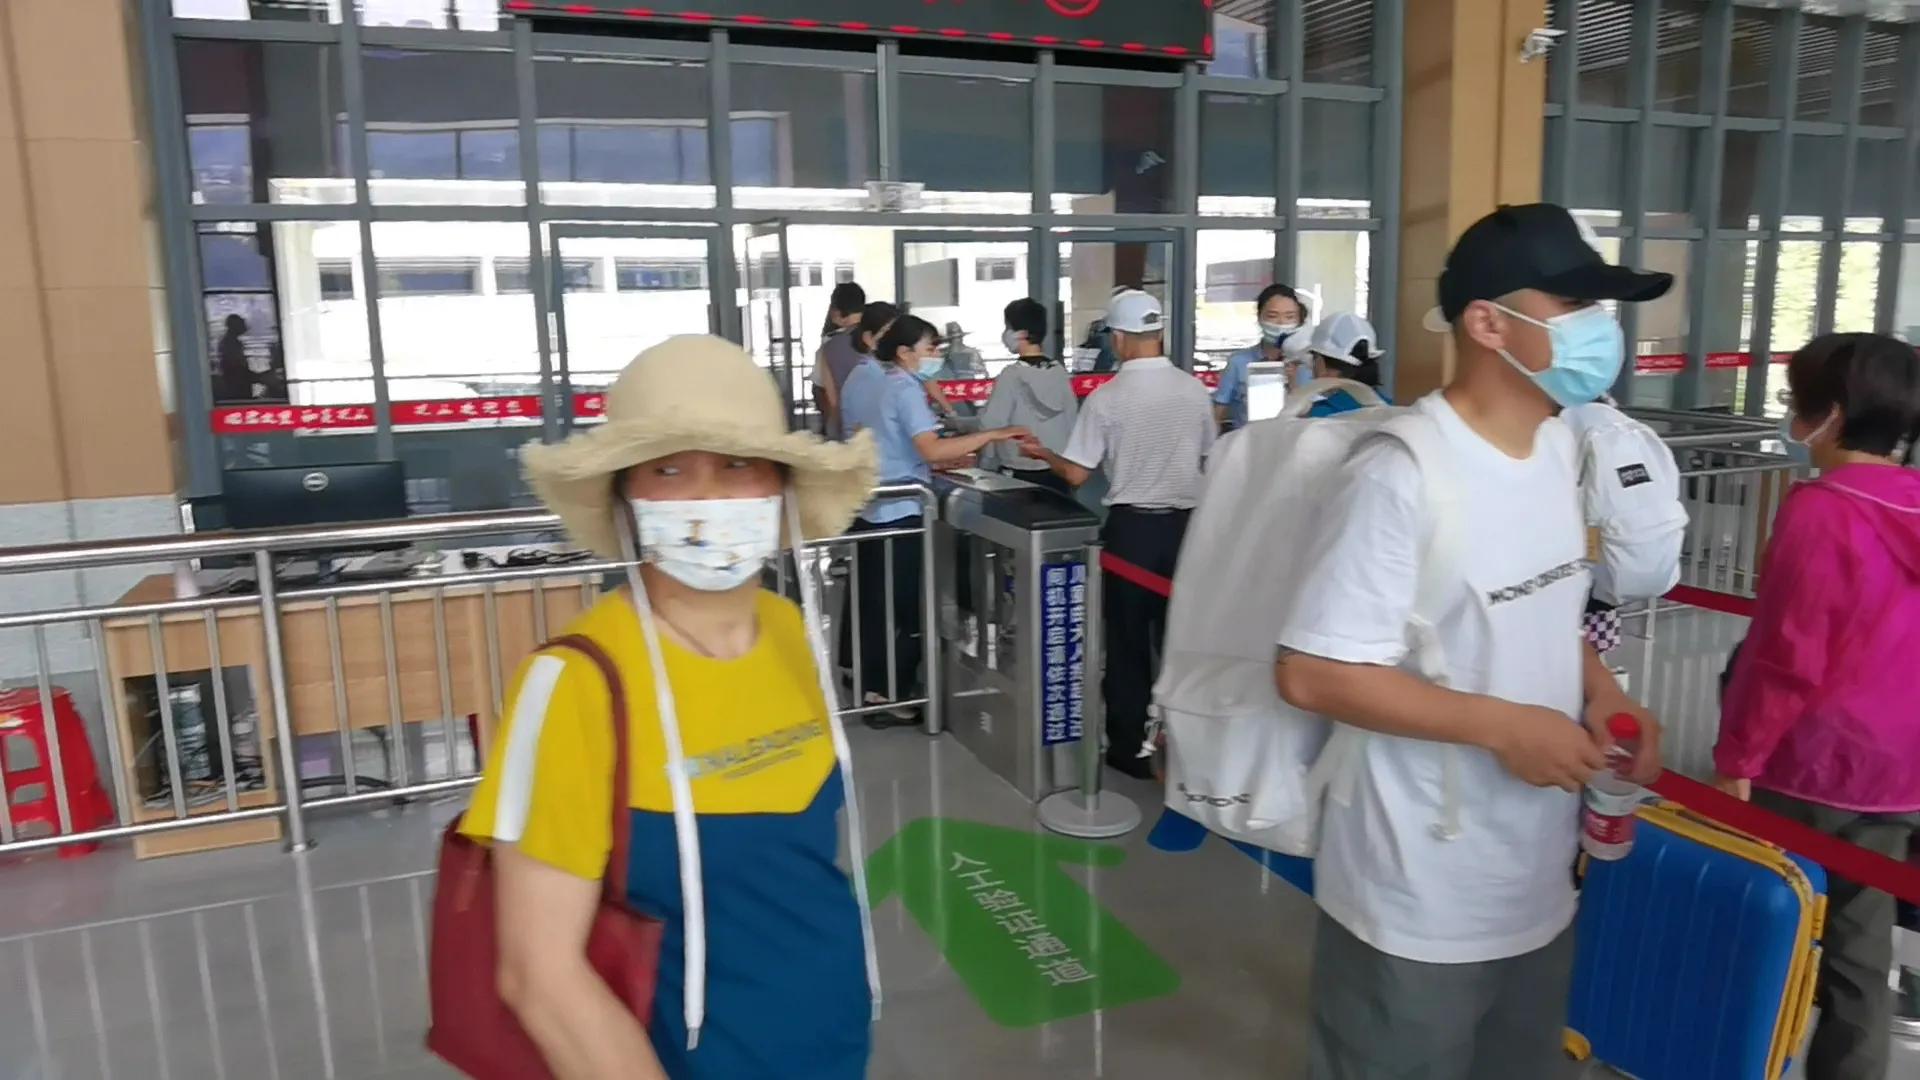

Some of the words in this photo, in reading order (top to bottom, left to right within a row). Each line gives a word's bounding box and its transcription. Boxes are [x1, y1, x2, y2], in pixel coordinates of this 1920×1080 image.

[949, 851, 1097, 986] 人工验证通道
